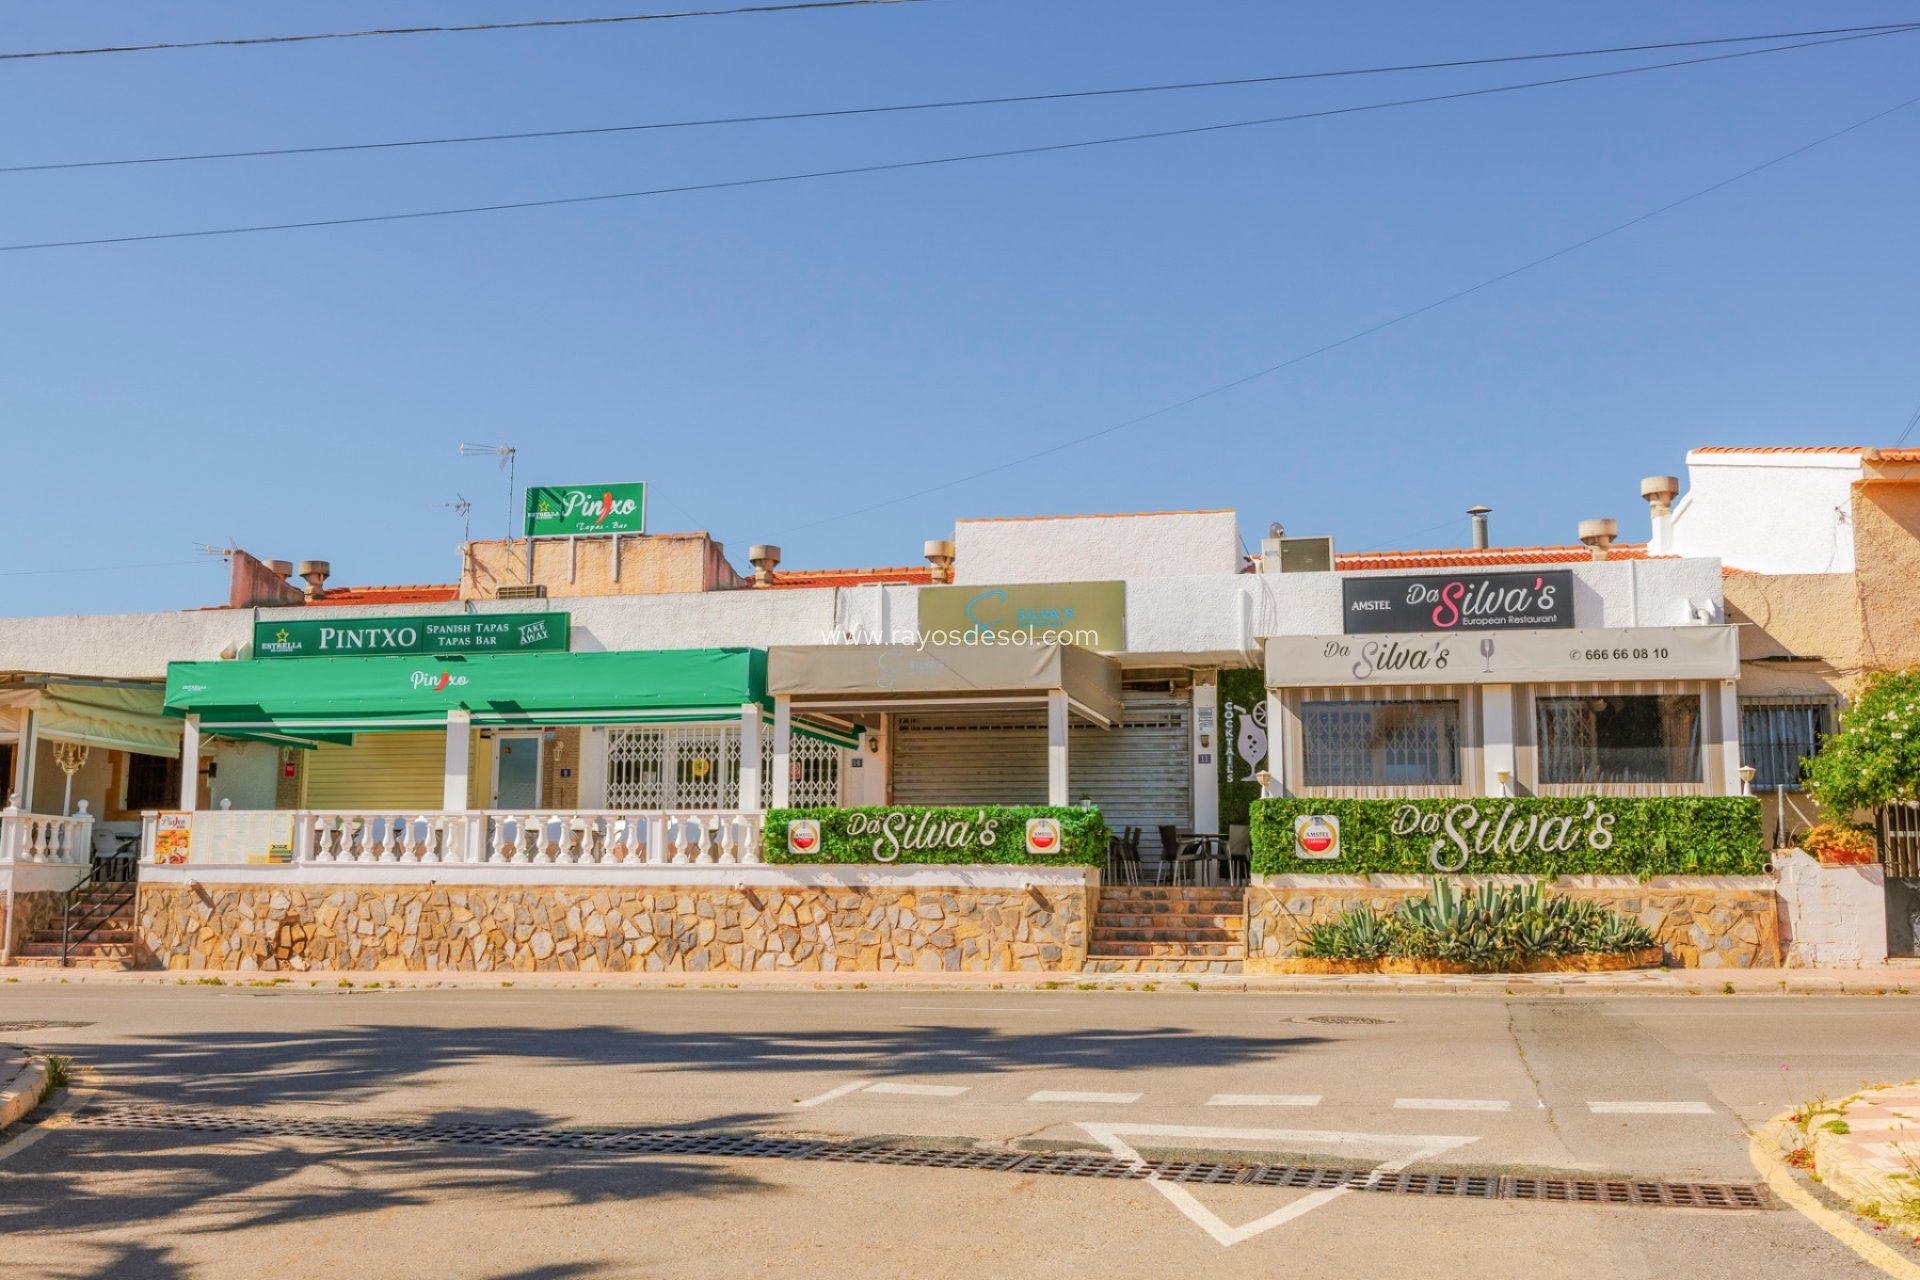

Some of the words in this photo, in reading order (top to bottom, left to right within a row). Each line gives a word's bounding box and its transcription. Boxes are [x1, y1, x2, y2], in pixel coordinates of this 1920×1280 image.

[576, 522, 603, 532] Tapas
[611, 521, 627, 530] Bar
[1351, 600, 1391, 611] AMSTEL
[1406, 583, 1439, 605] Da
[1432, 577, 1556, 627] Silva's
[1016, 607, 1073, 621] SILVA'S
[1462, 615, 1507, 626] European
[1508, 613, 1557, 624] Restaurant
[426, 624, 471, 634] SPANISH
[476, 623, 509, 633] TAPAS
[519, 622, 546, 636] TAKE
[318, 627, 417, 650] PINTXO
[438, 636, 471, 646] TAPAS
[475, 636, 497, 646] BAR
[520, 630, 548, 645] AWAY
[261, 642, 302, 650] ESTRELLA
[1323, 641, 1350, 658] Da
[1352, 640, 1450, 680] Silva's
[1585, 649, 1609, 661] 666
[1613, 648, 1629, 660] 66
[1632, 648, 1649, 660] 08
[1653, 647, 1669, 660] 10
[1224, 701, 1235, 783] COCKTAILS
[846, 812, 880, 835] Da
[872, 810, 999, 863] Silva's
[1391, 804, 1440, 835] Da
[1431, 800, 1615, 871] Silva's
